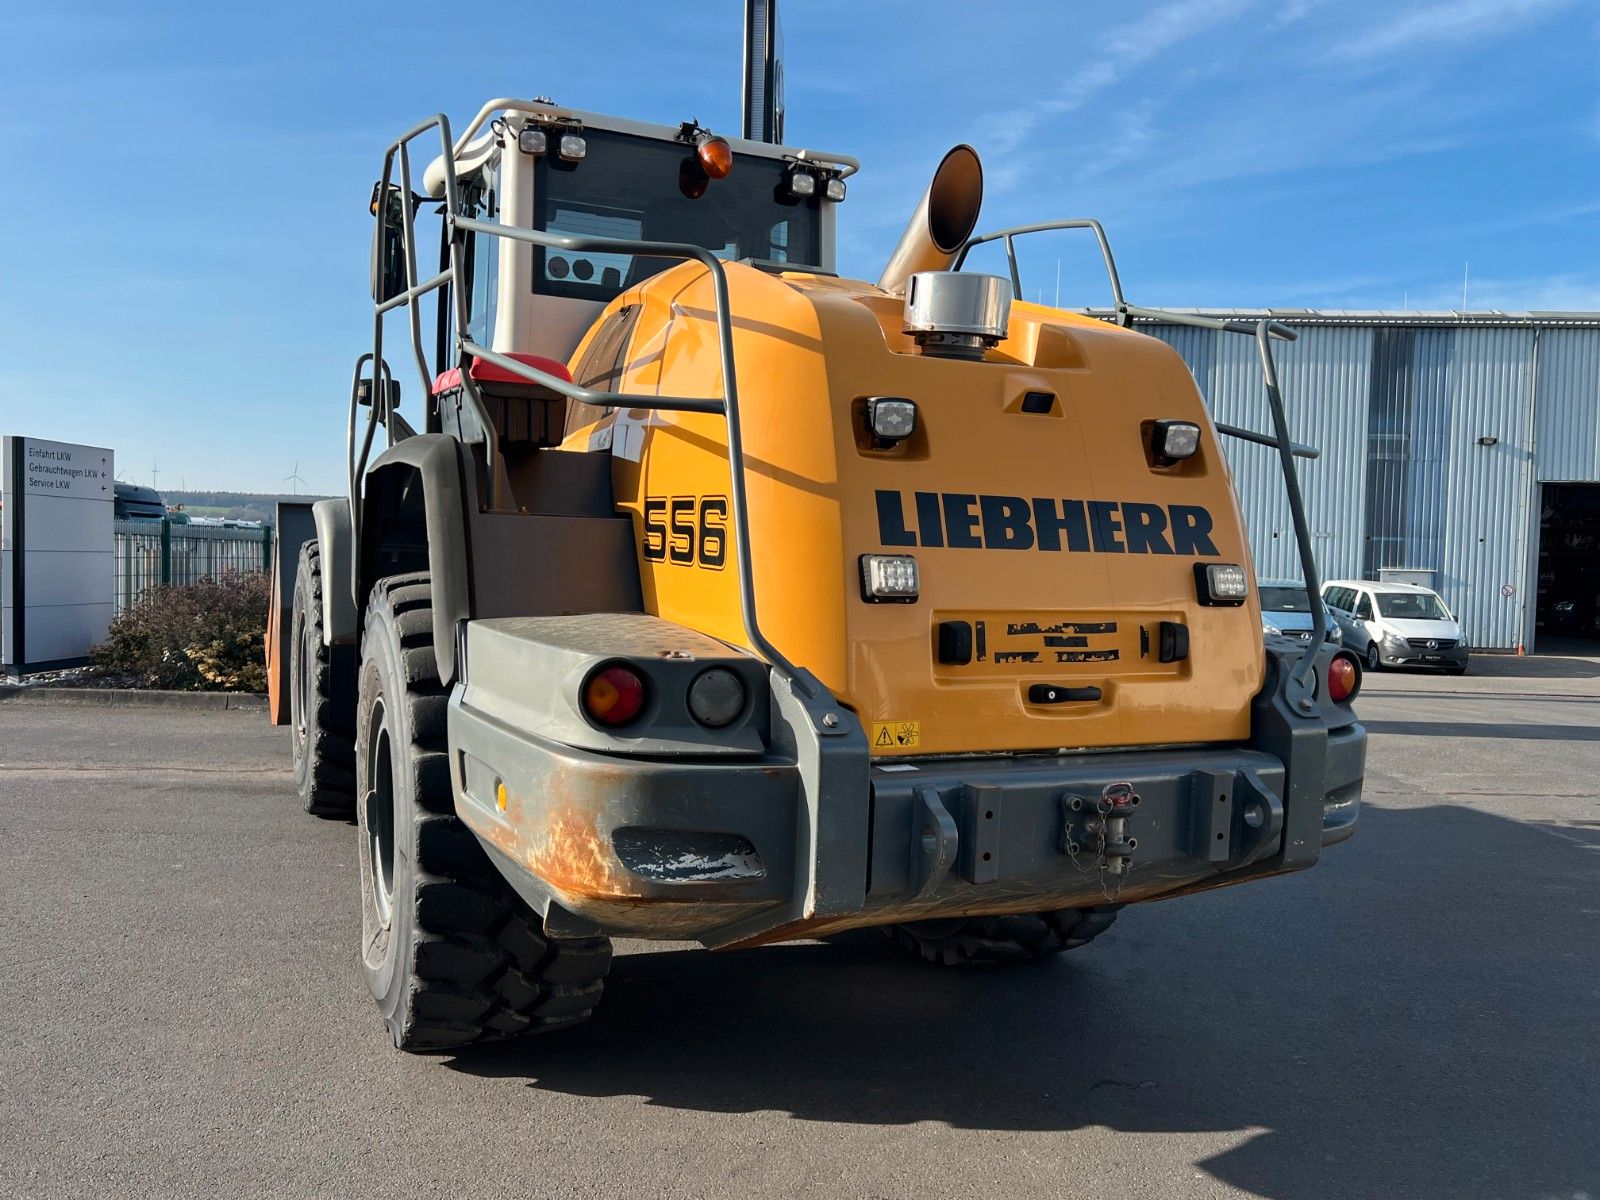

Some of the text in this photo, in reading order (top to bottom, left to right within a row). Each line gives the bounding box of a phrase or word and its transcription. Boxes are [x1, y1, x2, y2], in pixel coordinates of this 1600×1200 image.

[29, 447, 71, 461] Einfahrt LKW
[29, 462, 98, 478] Gebrauchtwagen LKW
[29, 477, 70, 489] Service LKW
[875, 489, 1220, 556] LIEBHERR
[643, 494, 728, 571] 556
